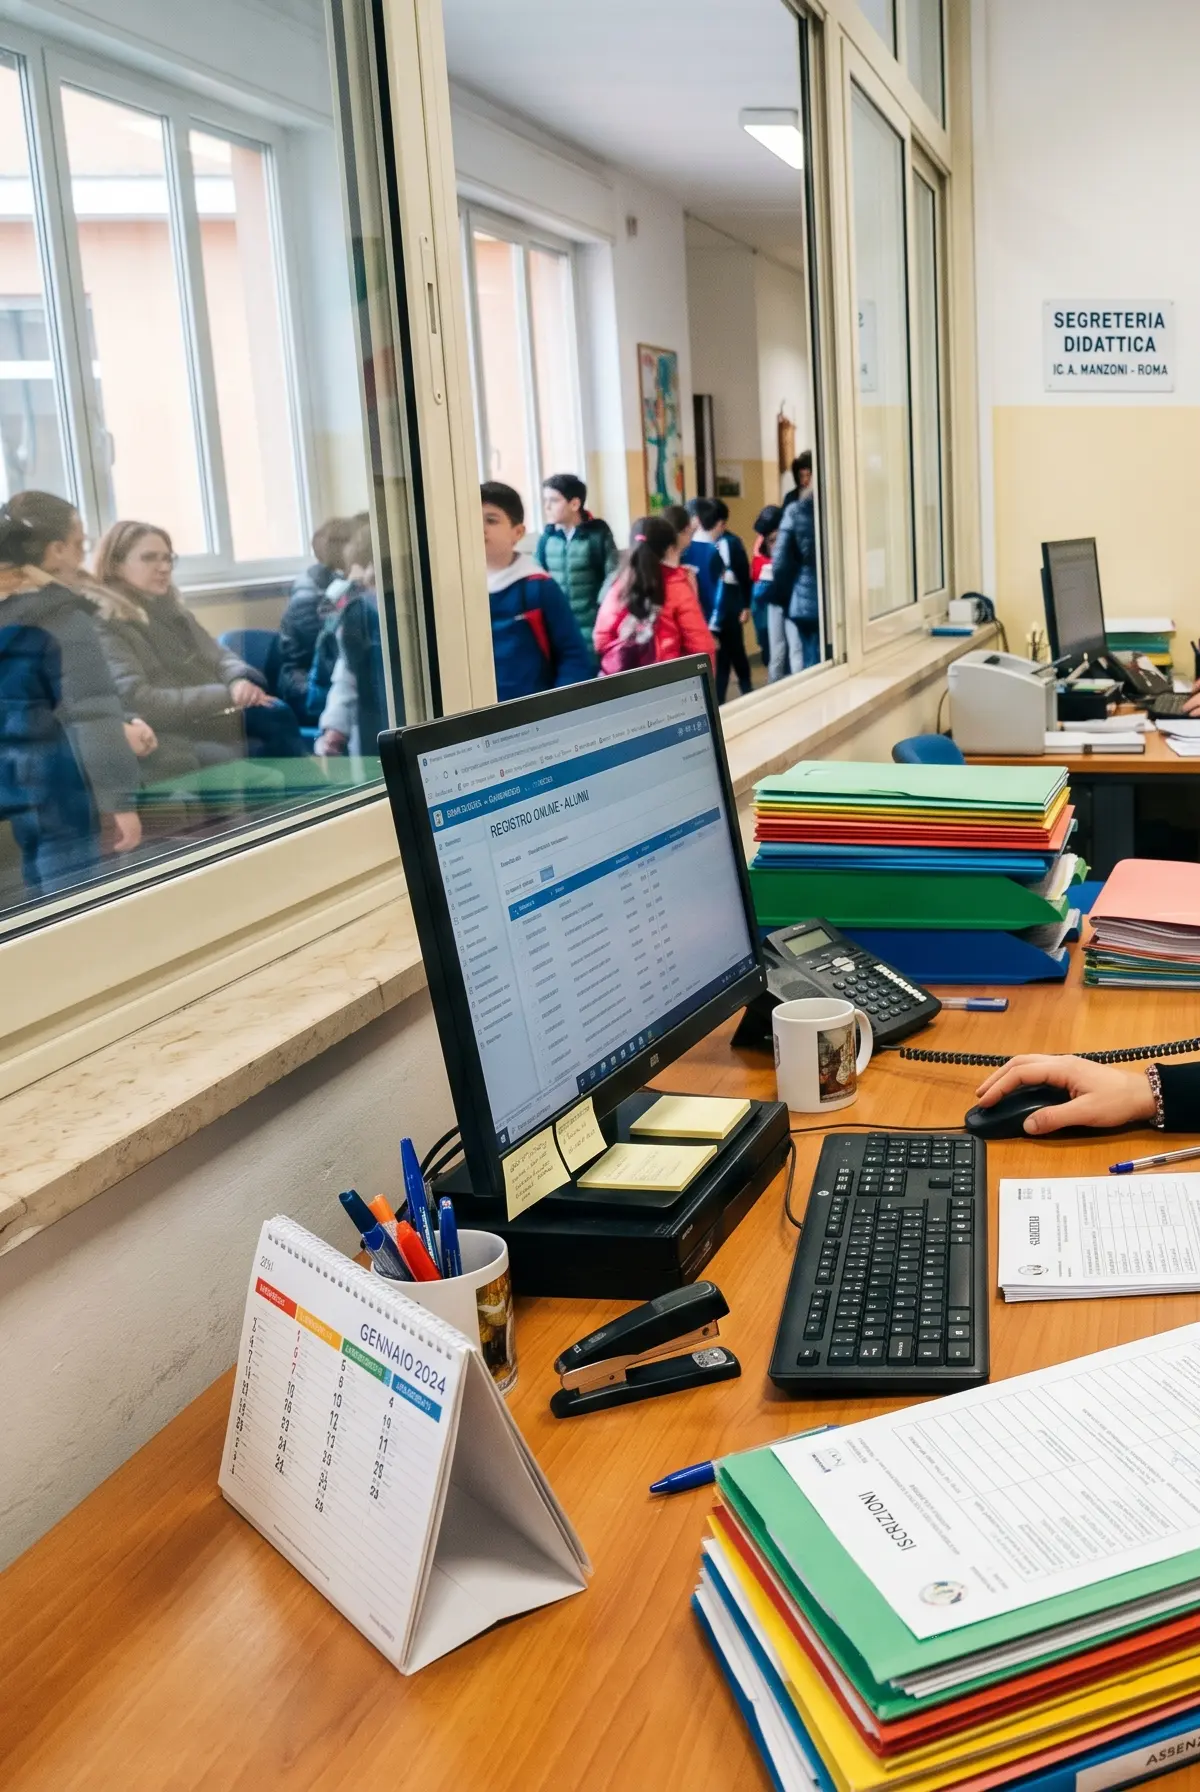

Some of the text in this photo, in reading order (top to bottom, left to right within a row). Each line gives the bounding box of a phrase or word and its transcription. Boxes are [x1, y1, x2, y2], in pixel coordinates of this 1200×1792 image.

[1054, 312, 1165, 328] SEGRETERIA
[1064, 336, 1156, 352] DIDATTICA
[1081, 364, 1128, 375] MANZONI
[1138, 364, 1168, 375] ROMA
[490, 811, 532, 838] REGISTRO
[360, 1323, 446, 1395] GENNAIO 2024
[858, 1491, 917, 1551] ISCRIZIONI
